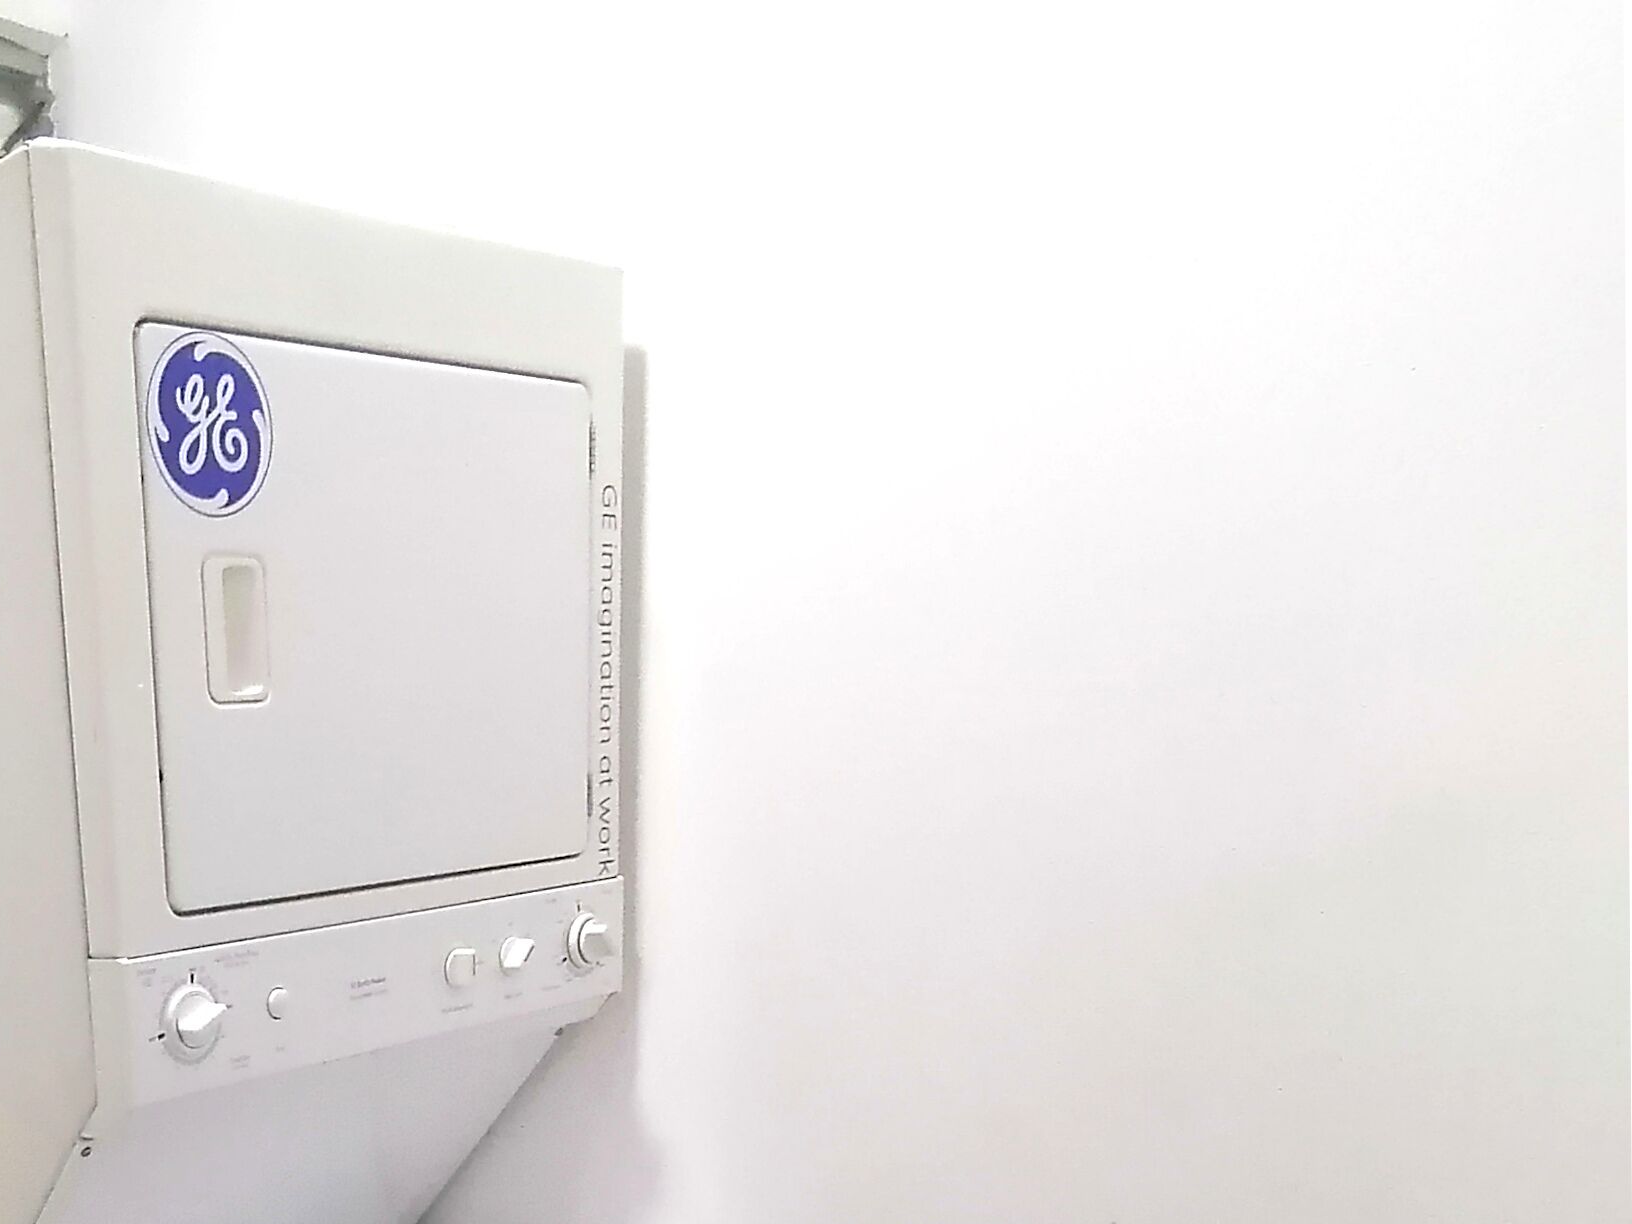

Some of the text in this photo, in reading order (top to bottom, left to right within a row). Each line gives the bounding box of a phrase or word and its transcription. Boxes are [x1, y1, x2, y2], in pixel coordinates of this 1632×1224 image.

[175, 373, 249, 475] GE
[597, 484, 618, 876] GE imagination at work
